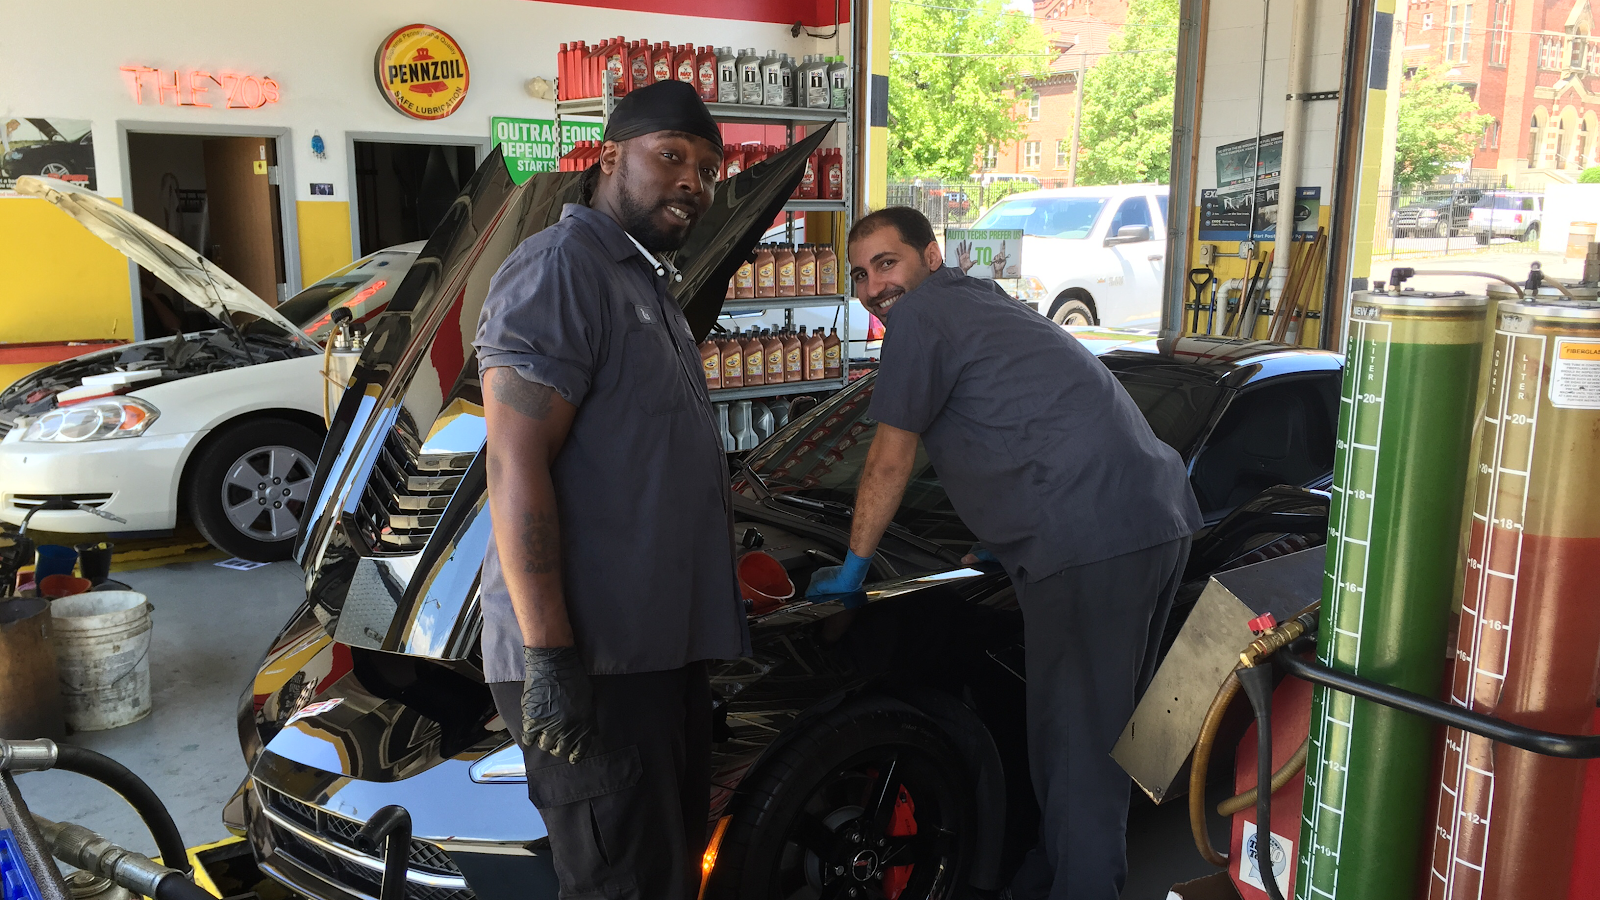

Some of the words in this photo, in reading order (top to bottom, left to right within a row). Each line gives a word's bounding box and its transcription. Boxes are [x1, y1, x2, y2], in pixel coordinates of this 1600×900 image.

[440, 37, 456, 55] Quality
[388, 59, 464, 85] PENNZOIL
[119, 66, 213, 108] THE
[394, 90, 414, 110] SAFE
[415, 86, 463, 115] LUBRICATION
[947, 230, 965, 240] AUTO
[967, 230, 988, 240] TECHS
[988, 230, 1012, 240] PREFER
[1012, 230, 1021, 240] US
[974, 246, 992, 266] TO
[1353, 306, 1368, 316] NEW
[1368, 307, 1378, 317] #1
[1367, 338, 1377, 380] LITER
[1491, 350, 1500, 395] QUART
[1518, 354, 1529, 400] LITER
[1363, 393, 1376, 404] 20
[1511, 413, 1526, 425] 20
[1480, 463, 1488, 474] 20
[1354, 489, 1365, 500] 18
[1500, 518, 1513, 529] 18
[1470, 559, 1477, 570] 18
[1345, 581, 1357, 593] 16
[1489, 620, 1502, 631] 16
[1460, 651, 1466, 662] 16
[1449, 741, 1457, 752] 14
[1328, 760, 1340, 772] 12
[1466, 812, 1480, 824] 12
[1439, 827, 1447, 840] 12
[1321, 845, 1331, 857] 10
